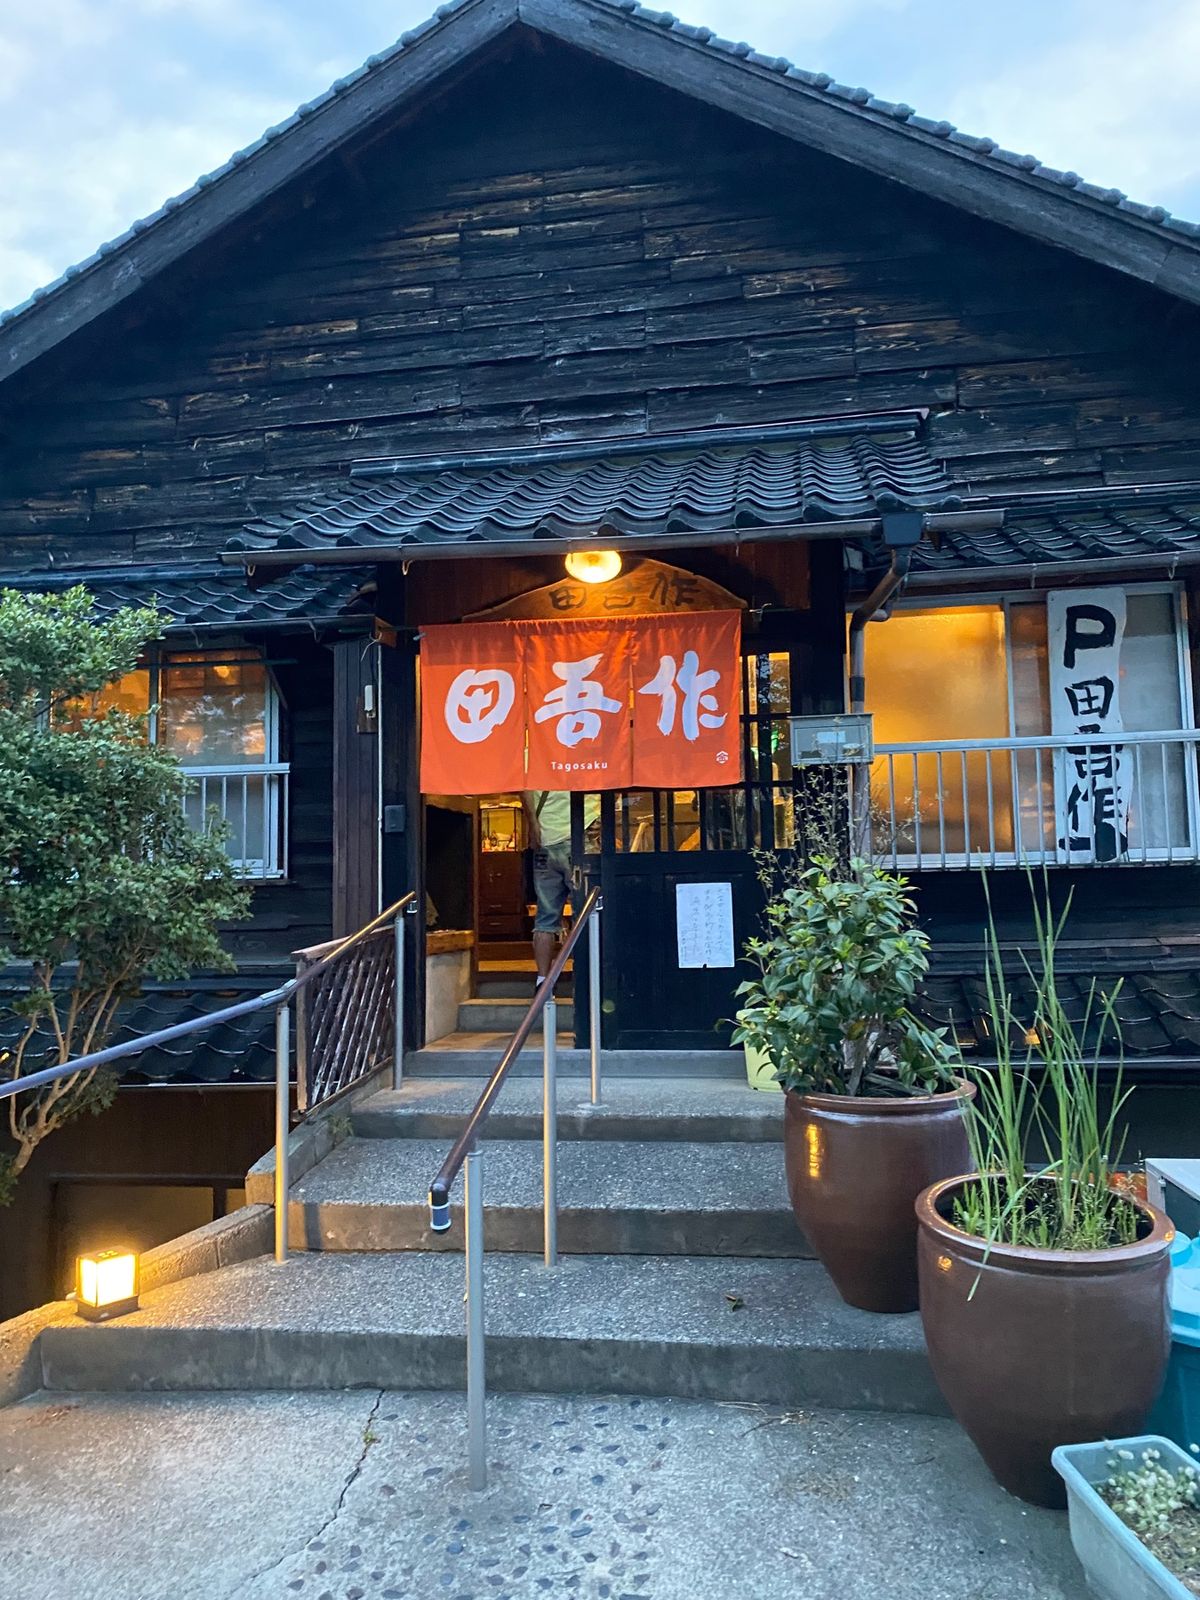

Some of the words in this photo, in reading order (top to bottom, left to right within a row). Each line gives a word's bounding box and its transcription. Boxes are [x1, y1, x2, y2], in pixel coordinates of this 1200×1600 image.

[445, 650, 728, 749] 田吾作
[551, 761, 608, 772] Tagosaku
